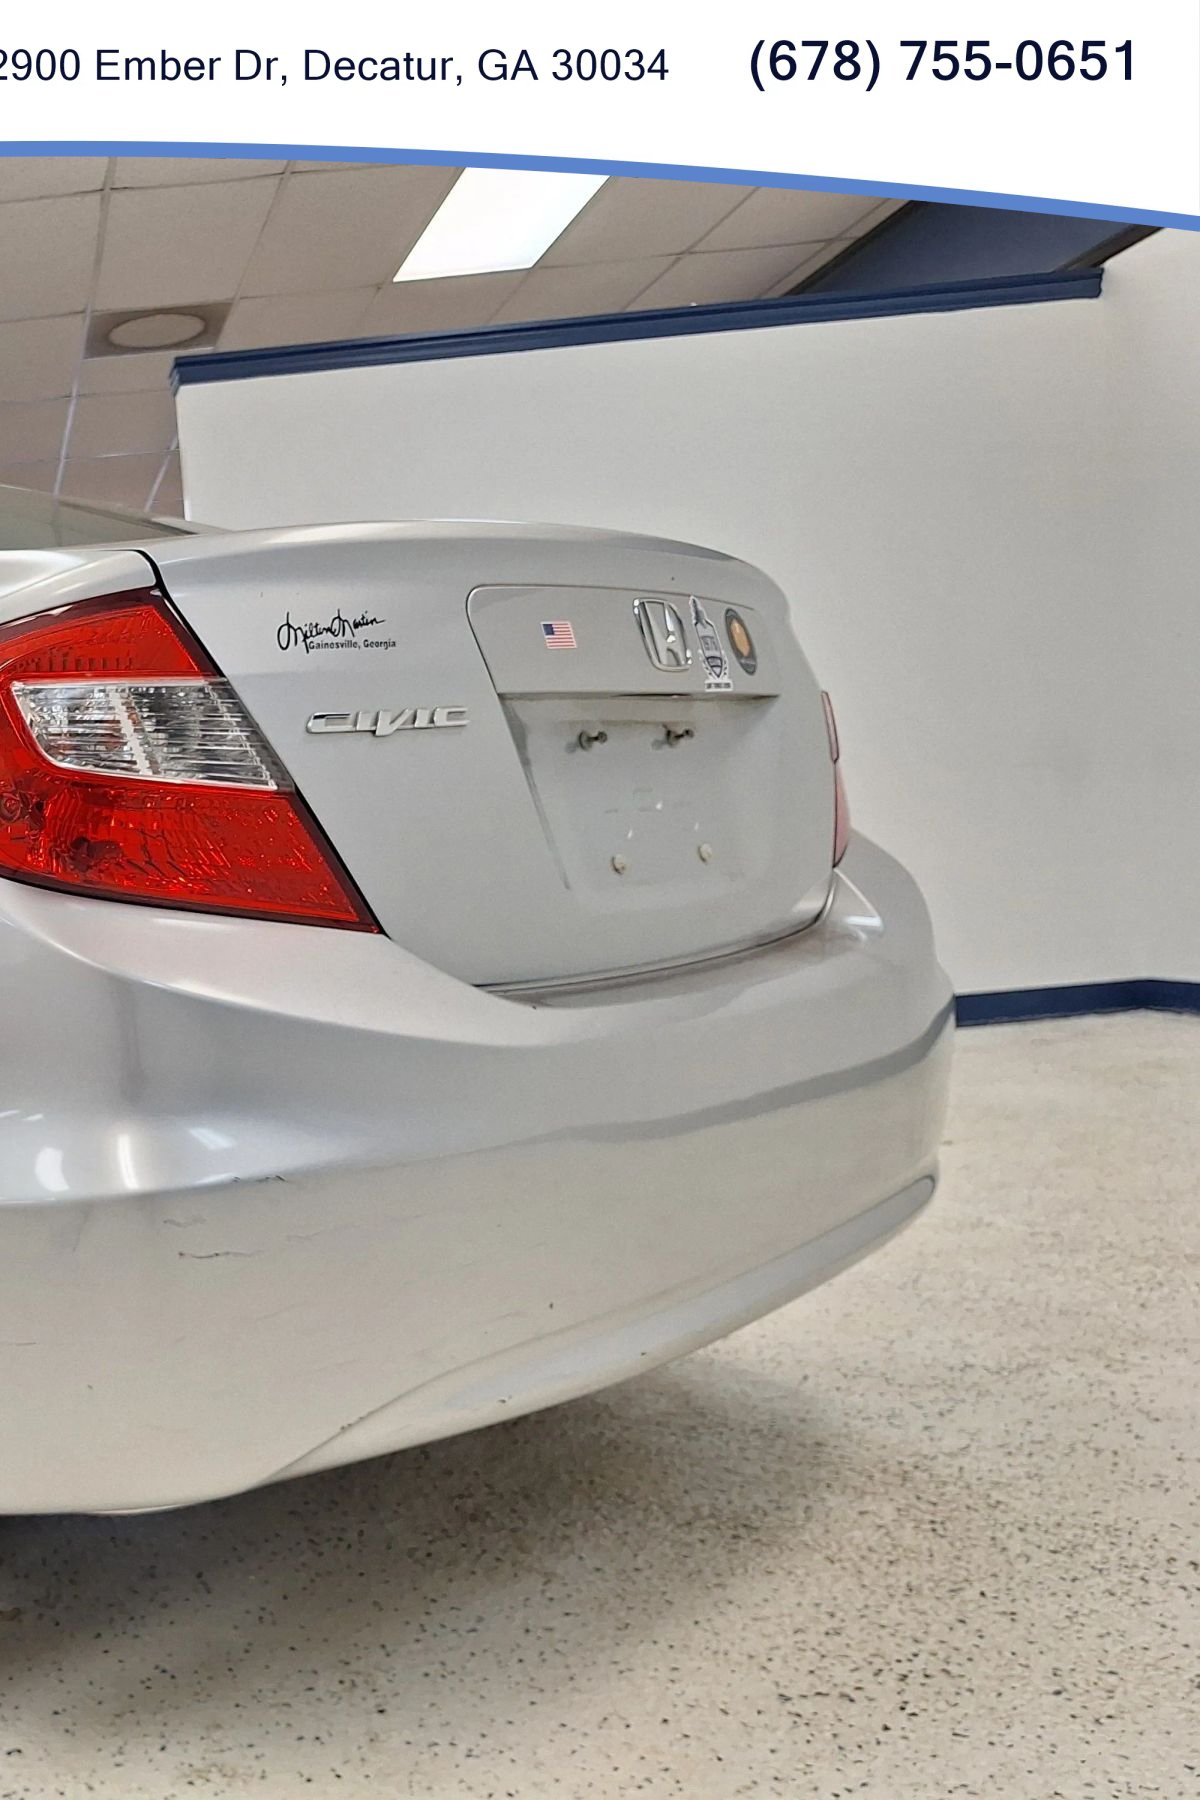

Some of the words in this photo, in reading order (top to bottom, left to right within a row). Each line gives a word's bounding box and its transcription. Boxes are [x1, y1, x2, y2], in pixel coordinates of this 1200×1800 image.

[308, 640, 361, 650] Gainesville,
[363, 639, 396, 650] Georgia
[306, 706, 471, 737] CIVIC
